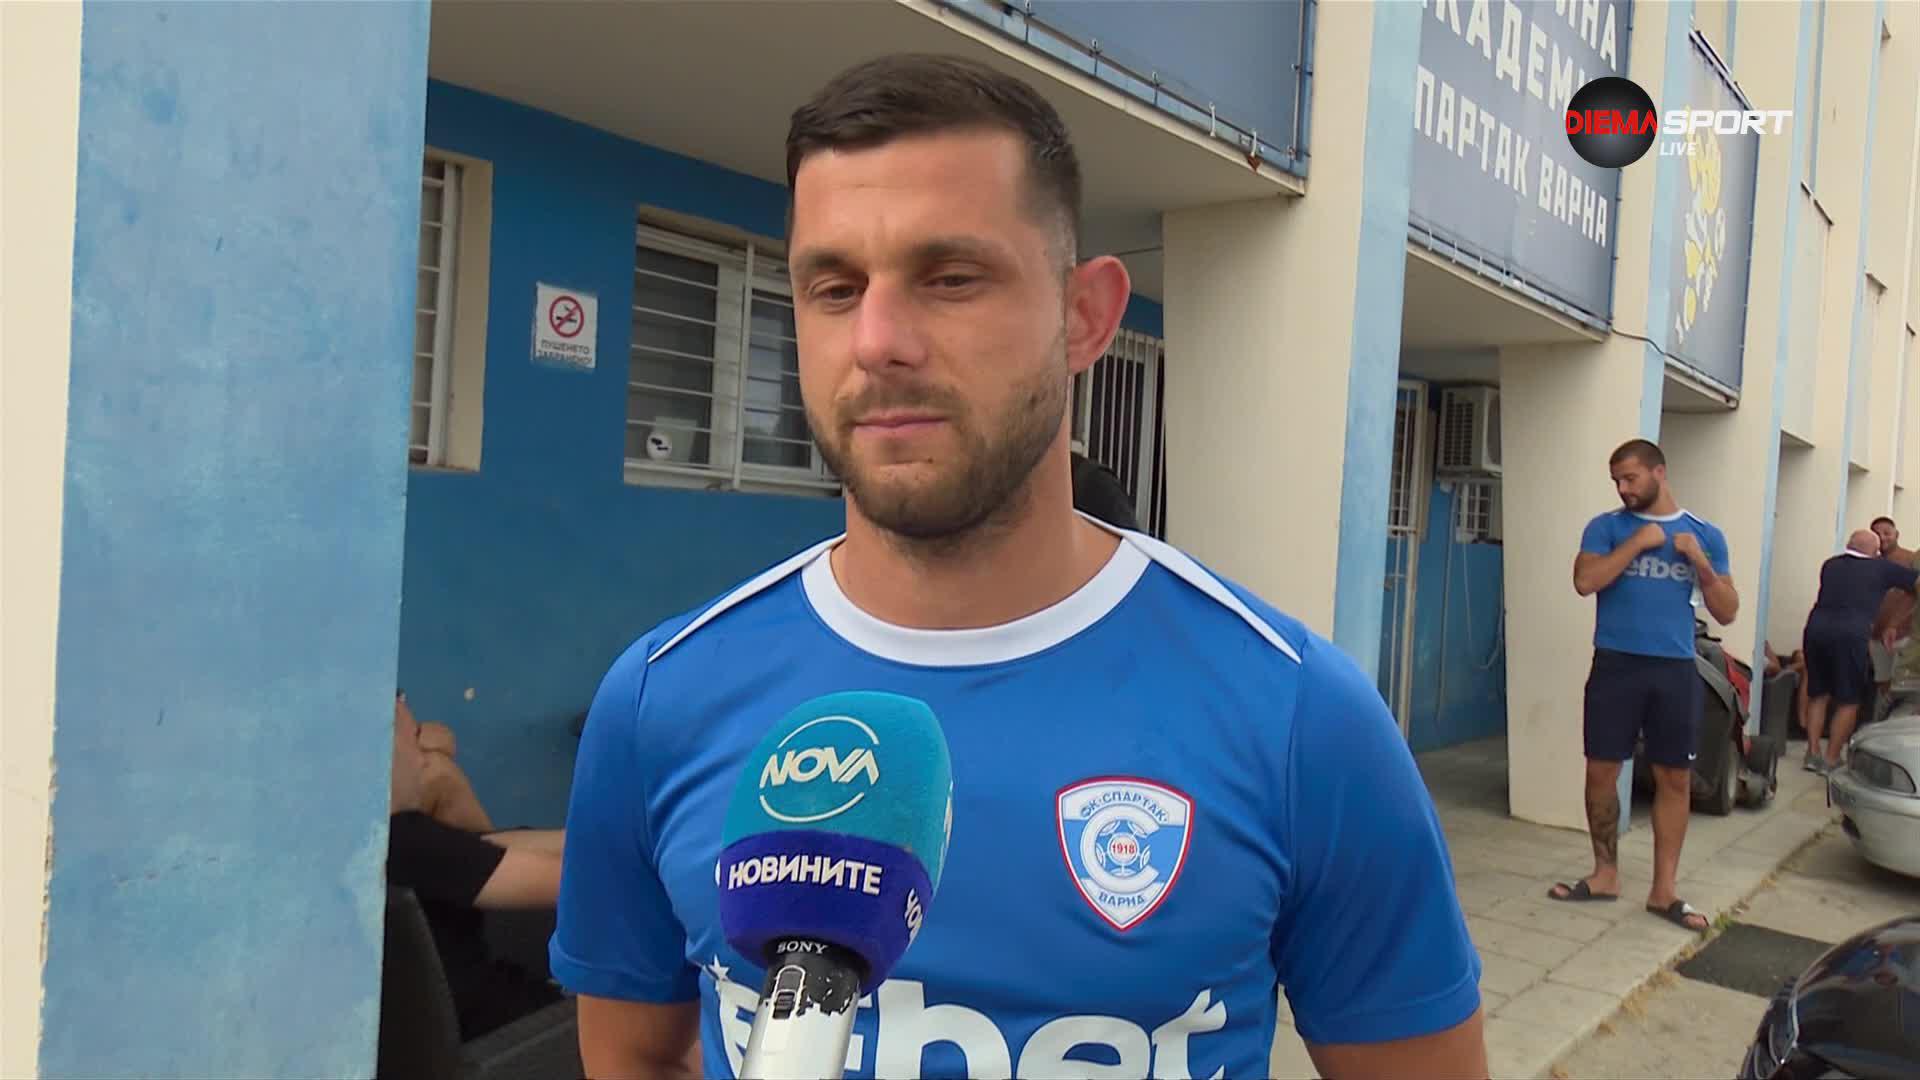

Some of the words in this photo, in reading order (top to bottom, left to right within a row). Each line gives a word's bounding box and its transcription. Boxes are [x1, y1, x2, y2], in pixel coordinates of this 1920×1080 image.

[1538, 153, 1608, 247] ВАРНА
[759, 746, 880, 788] NOVA
[1111, 843, 1136, 855] 1918
[728, 854, 882, 895] НОВИНИТЕ
[1098, 890, 1146, 907] ВАРНА
[776, 941, 828, 955] SONY
